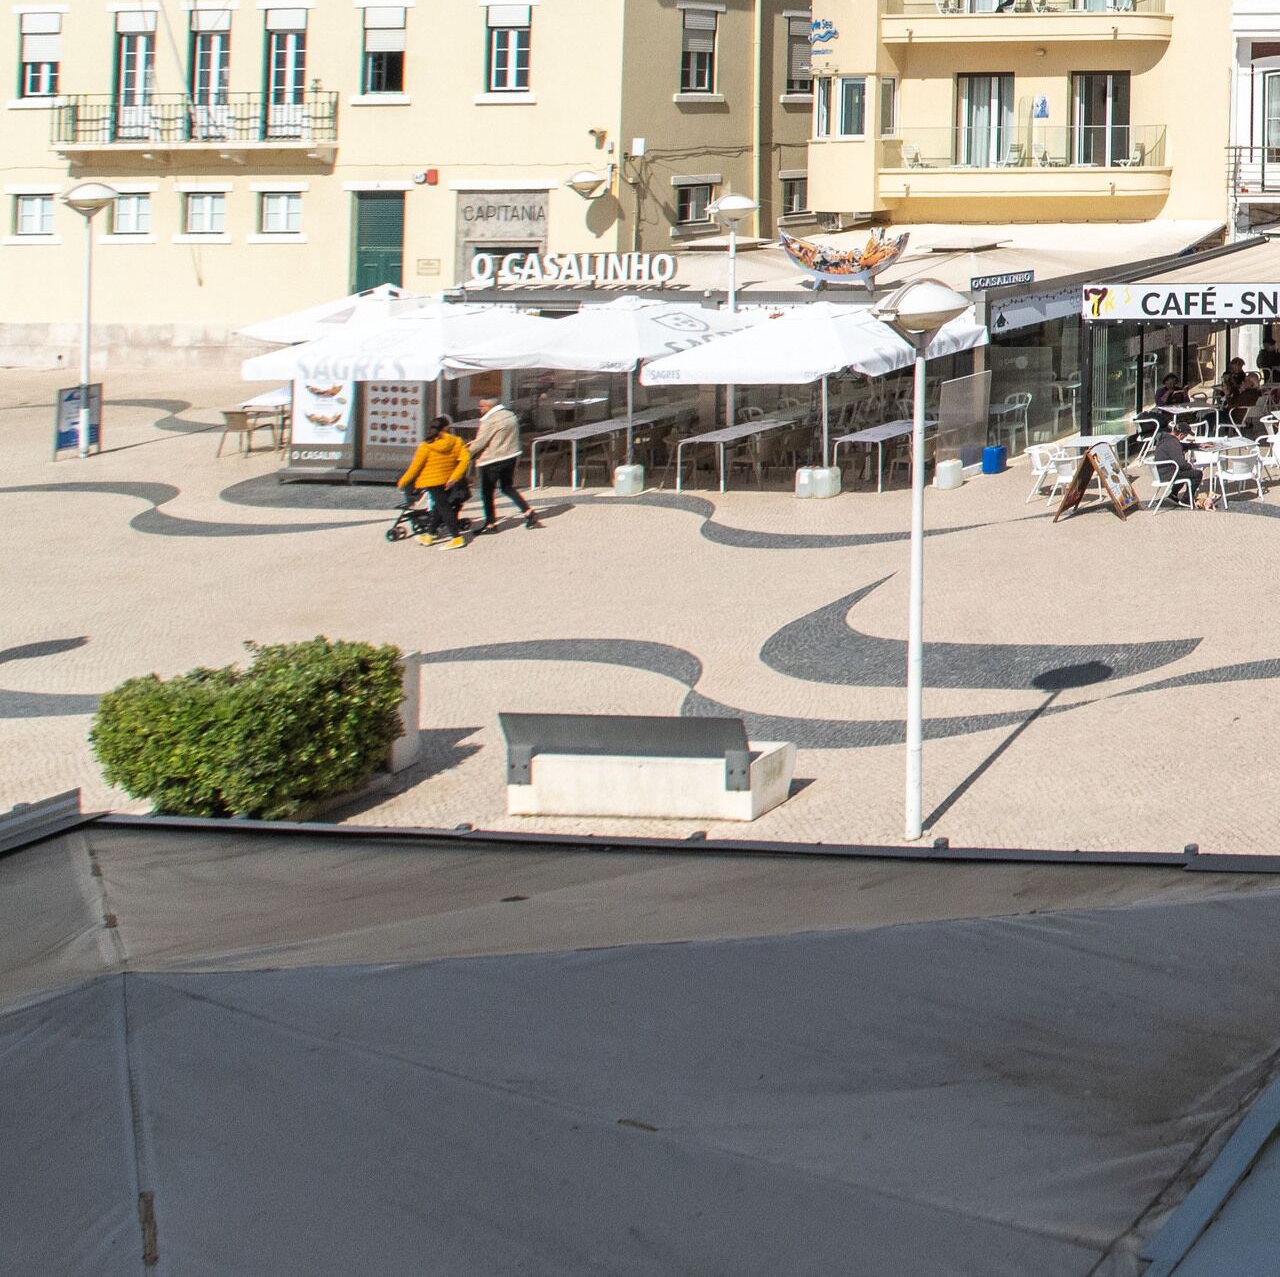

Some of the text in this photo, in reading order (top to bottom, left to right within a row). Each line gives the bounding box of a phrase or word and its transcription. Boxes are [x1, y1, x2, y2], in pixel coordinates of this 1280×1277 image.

[463, 204, 546, 222] CAPITANIA
[471, 253, 495, 281] O
[499, 253, 677, 282] CASALINHO
[1141, 286, 1216, 316] CAFÉ
